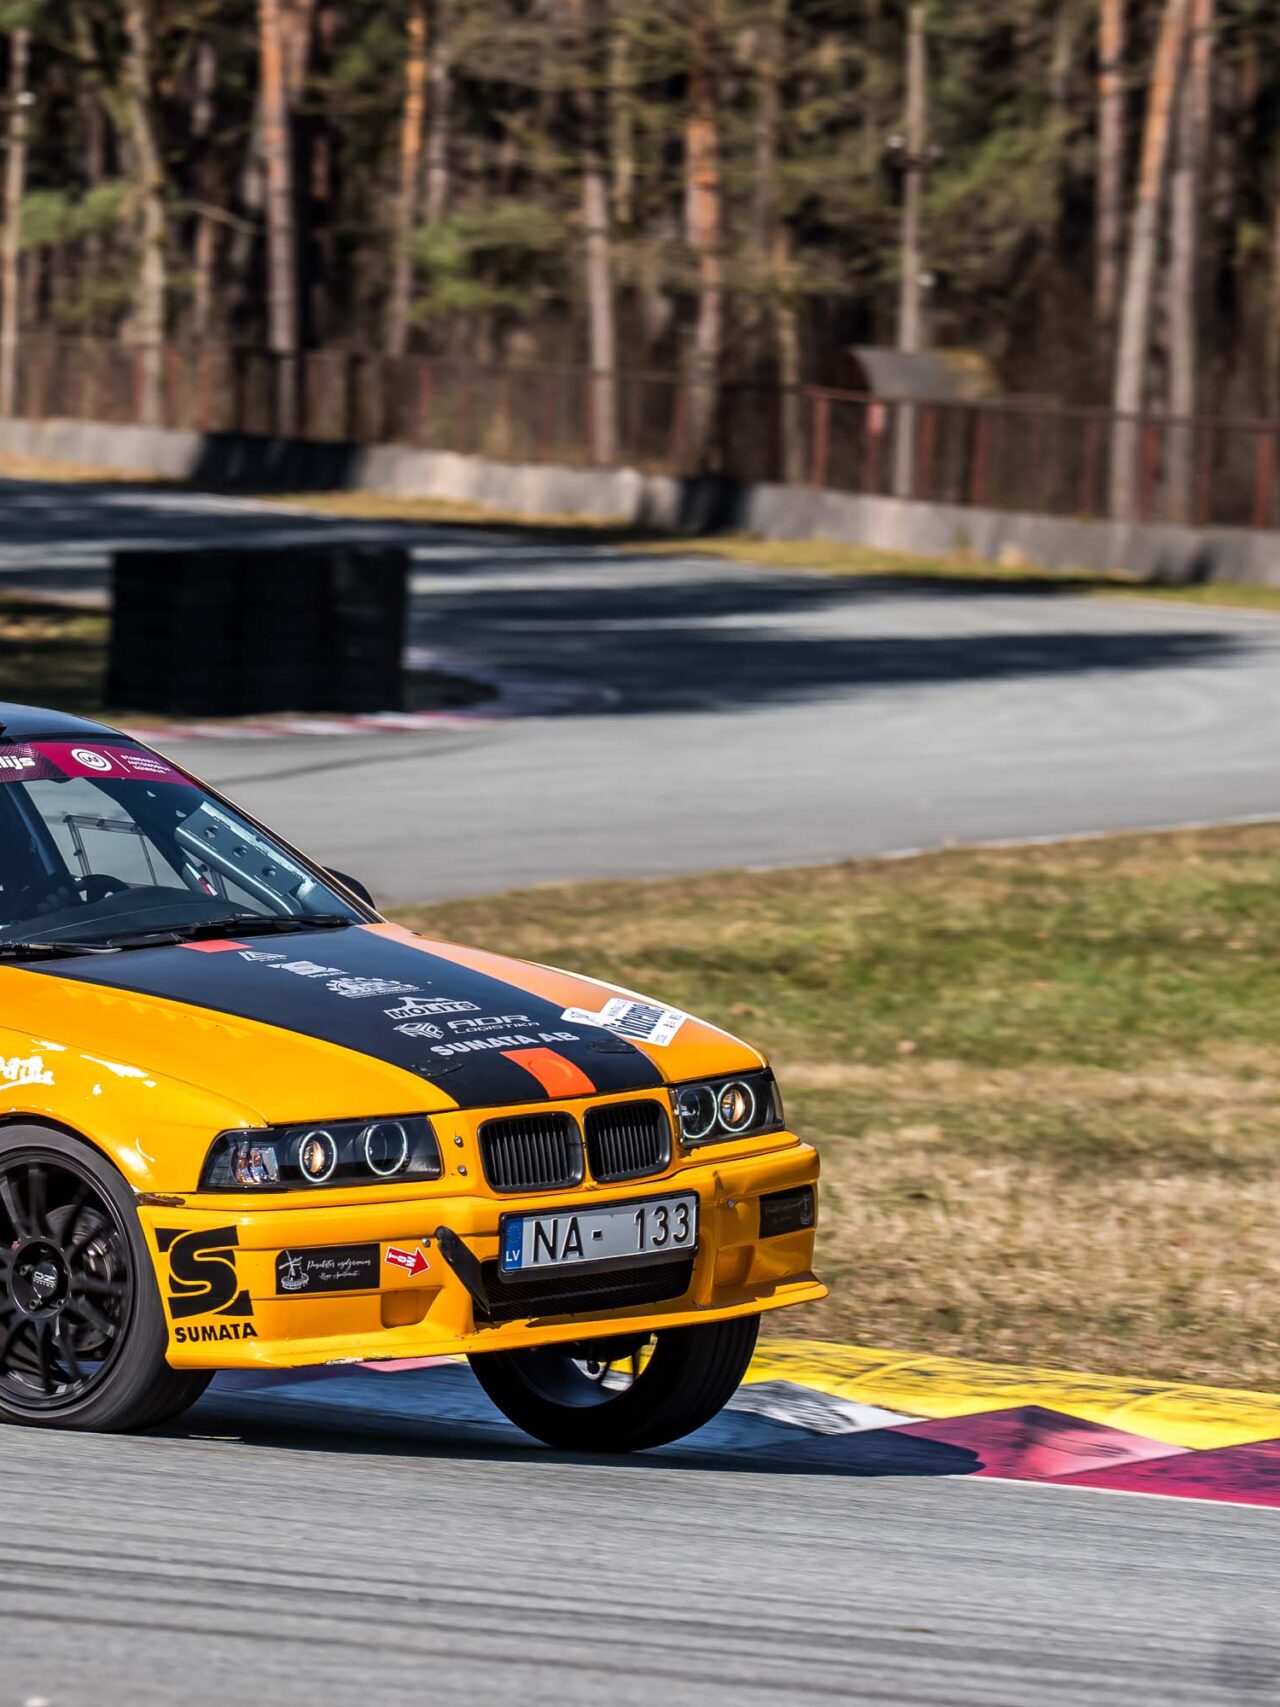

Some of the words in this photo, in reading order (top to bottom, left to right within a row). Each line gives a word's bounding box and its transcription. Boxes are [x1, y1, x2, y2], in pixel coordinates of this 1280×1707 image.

[392, 1001, 476, 1018] MOLITS
[447, 1015, 531, 1029] ADR
[430, 1034, 540, 1056] SUMATA
[538, 1031, 580, 1043] AB
[532, 1216, 584, 1263] NA
[634, 1202, 690, 1250] 133
[388, 1252, 417, 1268] TOW
[505, 1249, 521, 1263] LV
[175, 1322, 258, 1344] SUMATA
